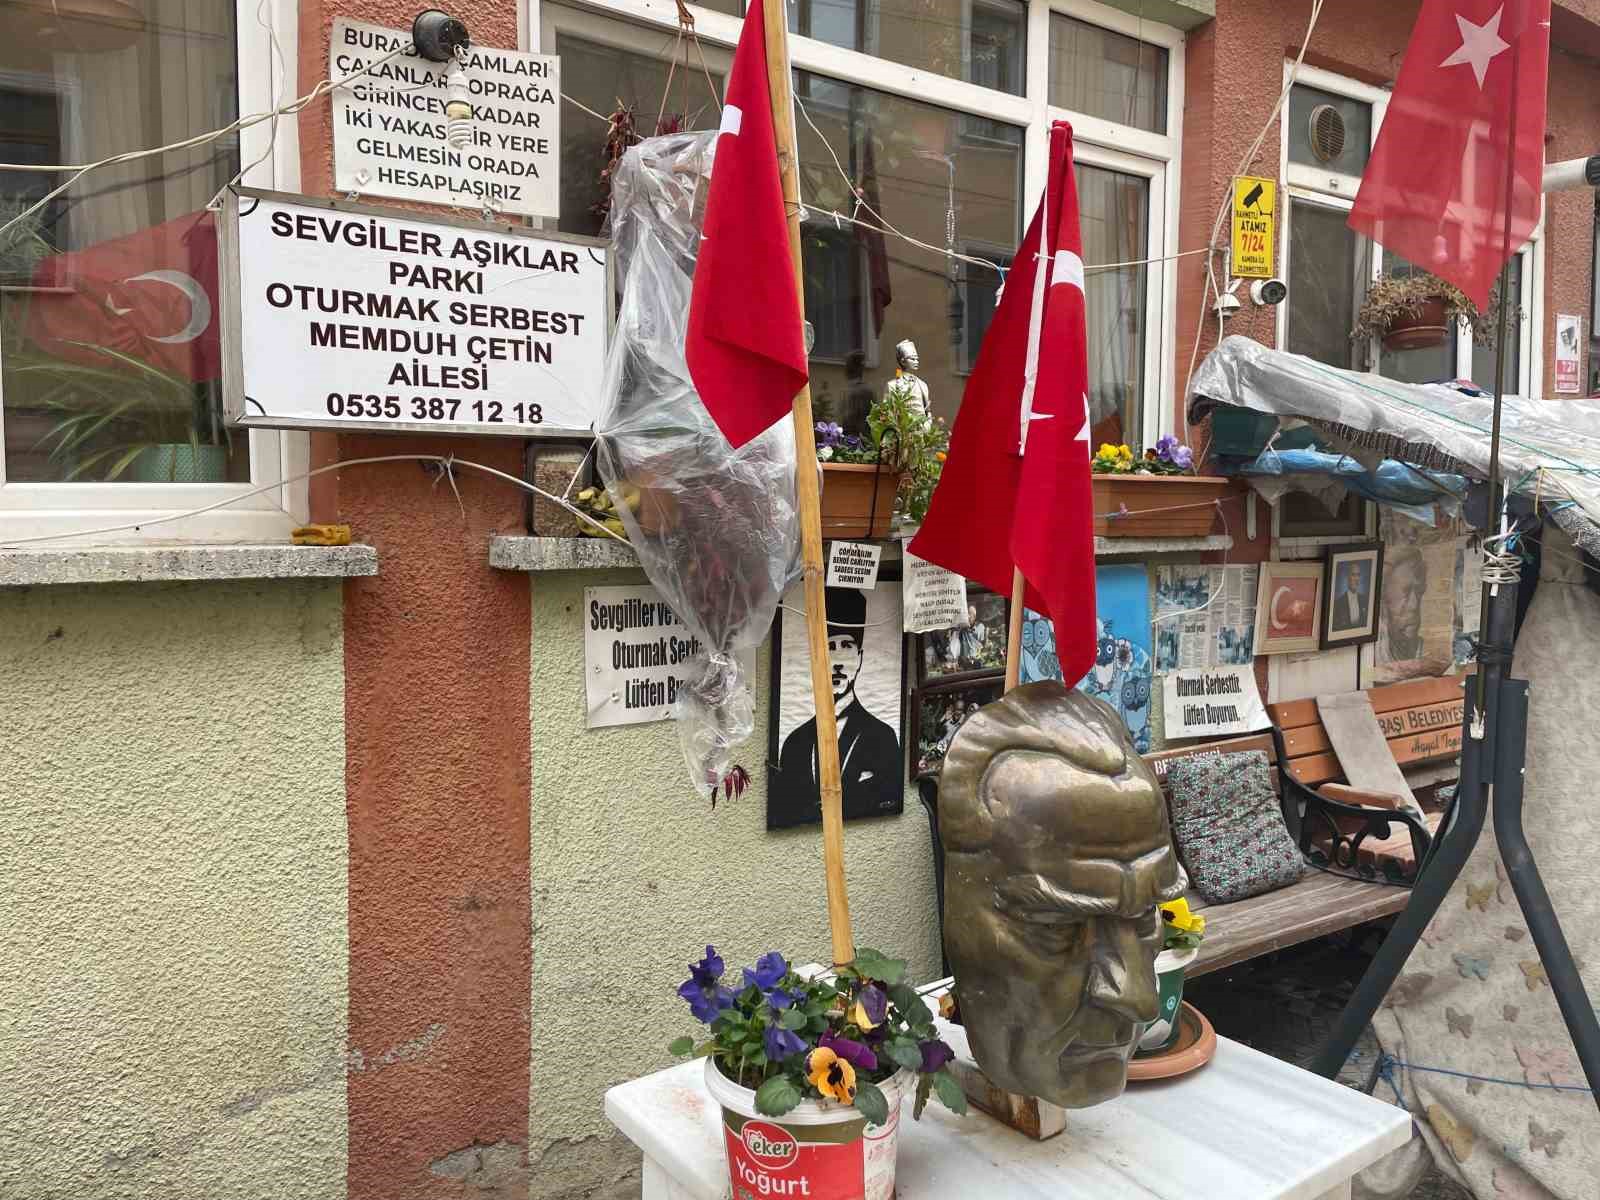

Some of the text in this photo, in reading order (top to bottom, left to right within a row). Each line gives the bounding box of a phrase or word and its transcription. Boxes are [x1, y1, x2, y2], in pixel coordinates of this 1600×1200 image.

[344, 27, 416, 56] BURA
[336, 55, 555, 105] ÇALANLAR OPRAĞA
[352, 82, 541, 129] GİRİNCEY KADAR
[345, 104, 550, 155] İKİ YAKAS İR YERE
[356, 138, 540, 178] GELMESİN ORADA
[378, 167, 522, 201] HESAPLAŞIRIZ
[271, 211, 579, 274] SEVGİLER AŞIKLAR
[1241, 221, 1266, 233] ATAMIZ
[1241, 233, 1264, 252] 7/24
[389, 261, 483, 295] PARKI
[266, 283, 585, 336] OTURMAK SERBEST
[310, 321, 552, 364] MEMDUH ÇETİN
[388, 358, 489, 391] AİLESİ
[326, 392, 543, 424] 0535 387 12 18
[591, 598, 673, 633] Sevgililer ve
[612, 637, 668, 670] Oturmak
[625, 678, 665, 709] Lütfen
[1176, 673, 1242, 697] Oturmak Serbesttir.
[1184, 703, 1240, 726] Lütfen Buyurun.
[1378, 705, 1464, 735] BAŞI BELEDİYES
[752, 1138, 792, 1155] eker
[735, 1156, 811, 1195] Yoğurt
